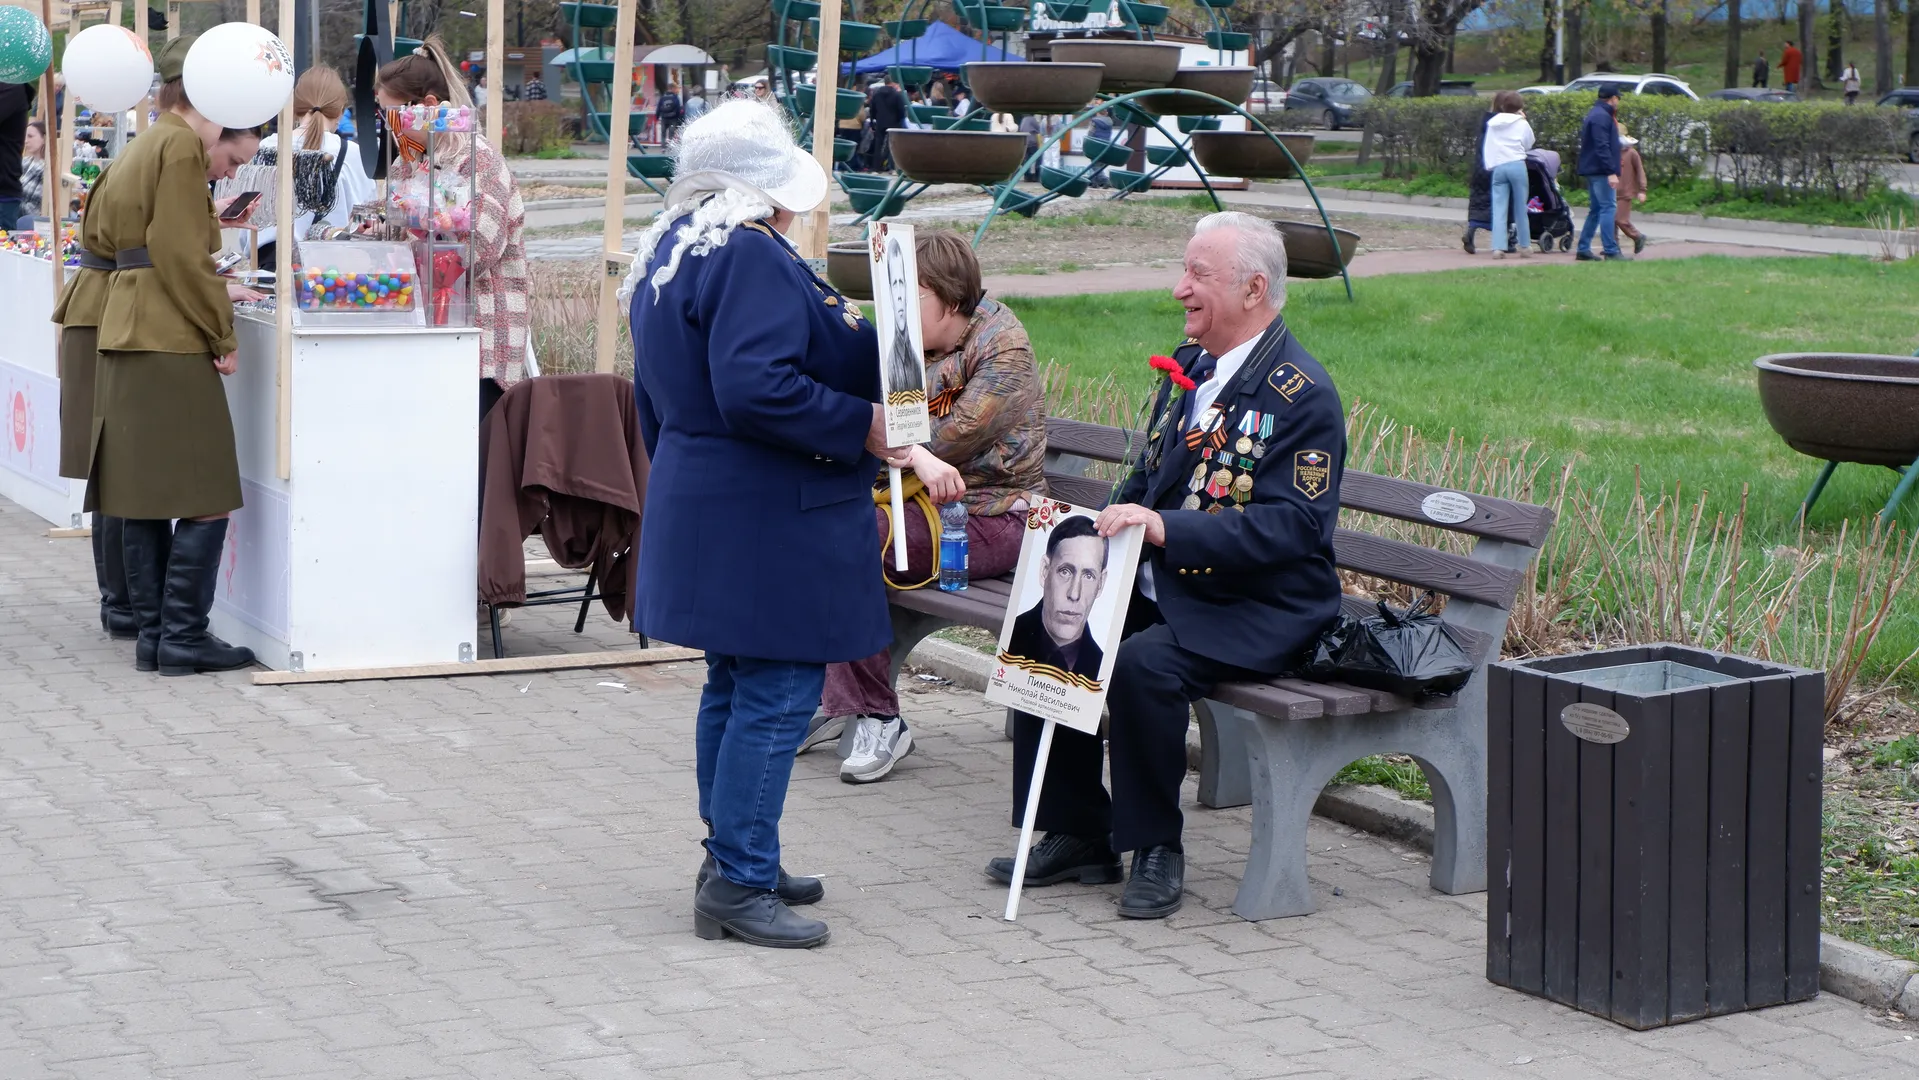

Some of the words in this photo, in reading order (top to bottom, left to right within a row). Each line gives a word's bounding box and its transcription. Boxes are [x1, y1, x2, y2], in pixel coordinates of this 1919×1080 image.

[1297, 465, 1328, 473] РОССИЙСКИЕ
[1027, 675, 1067, 696] Пименов
[1007, 682, 1038, 701] Николай
[1039, 692, 1081, 713] Васильевич
